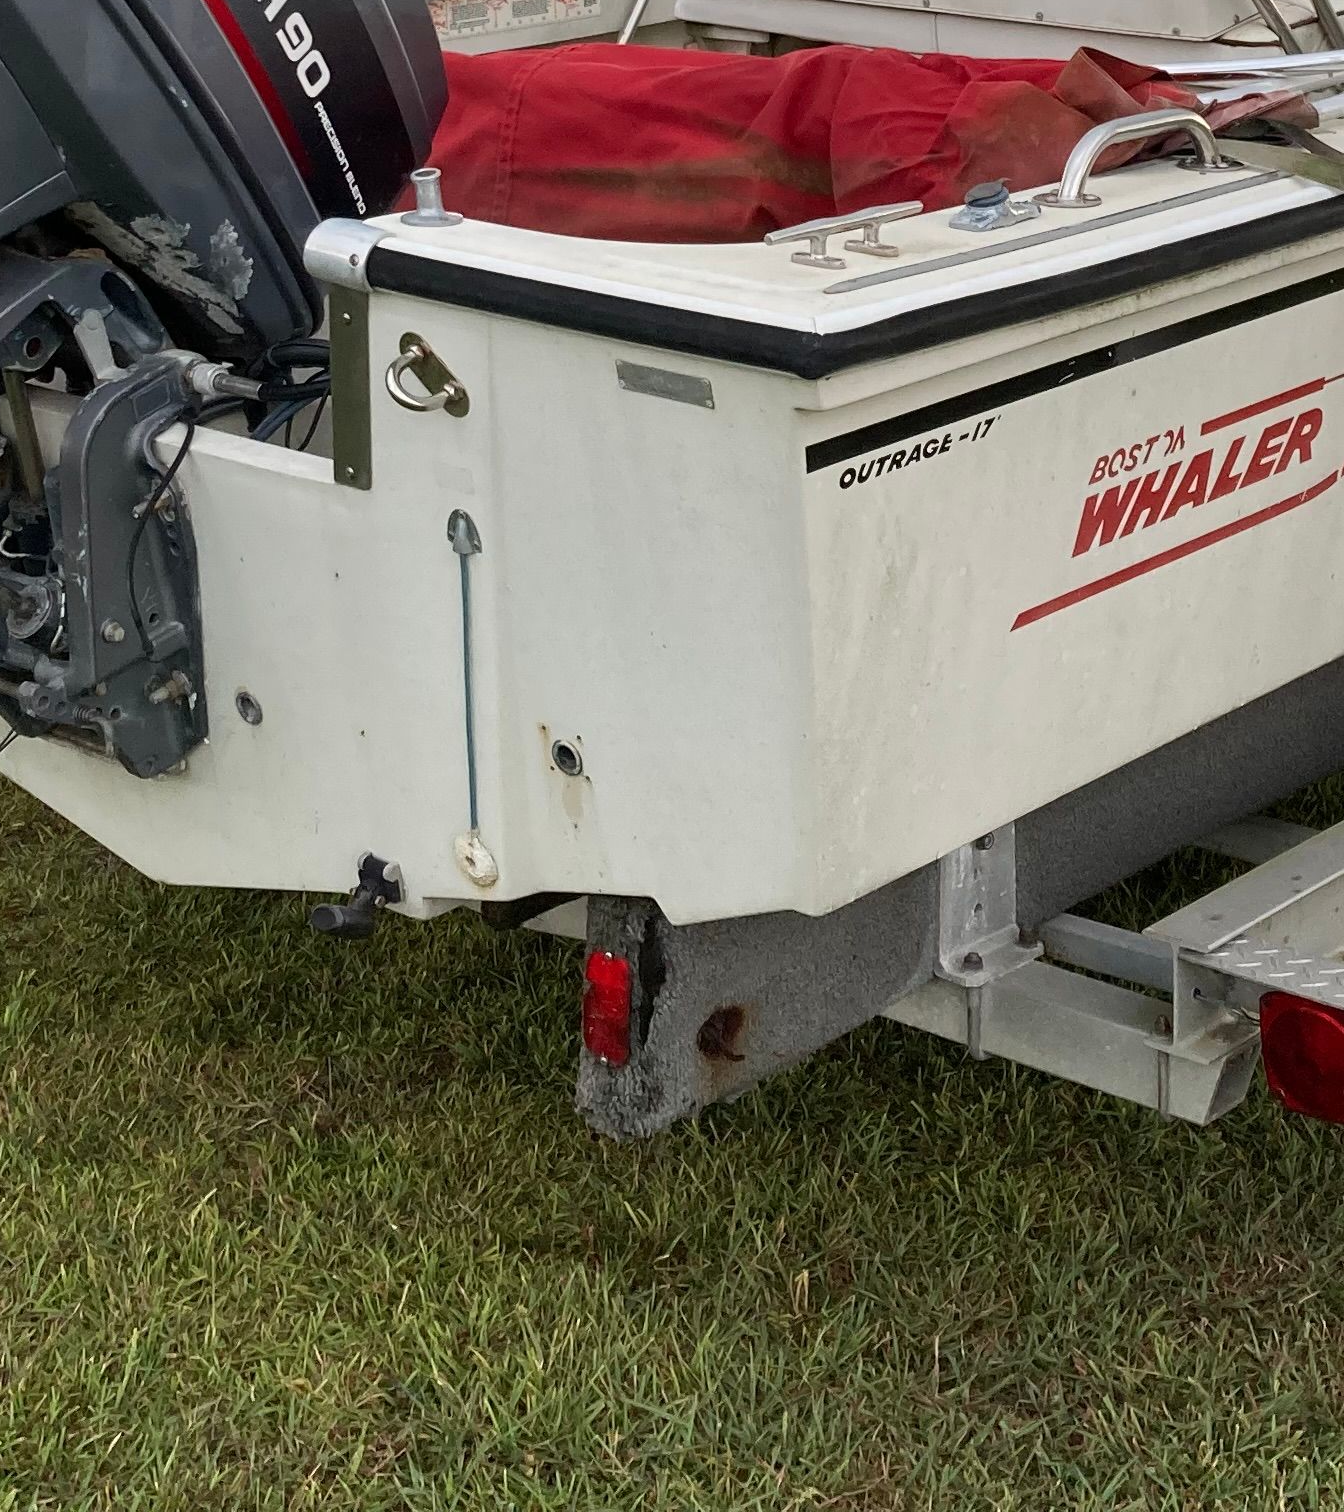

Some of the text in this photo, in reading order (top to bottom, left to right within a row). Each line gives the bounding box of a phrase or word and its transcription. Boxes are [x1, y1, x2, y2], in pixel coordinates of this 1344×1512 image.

[275, 11, 331, 98] 90
[314, 100, 367, 215] PRECISION BLEND
[839, 432, 953, 489] OUTRAGE
[1071, 407, 1324, 559] WHALER
